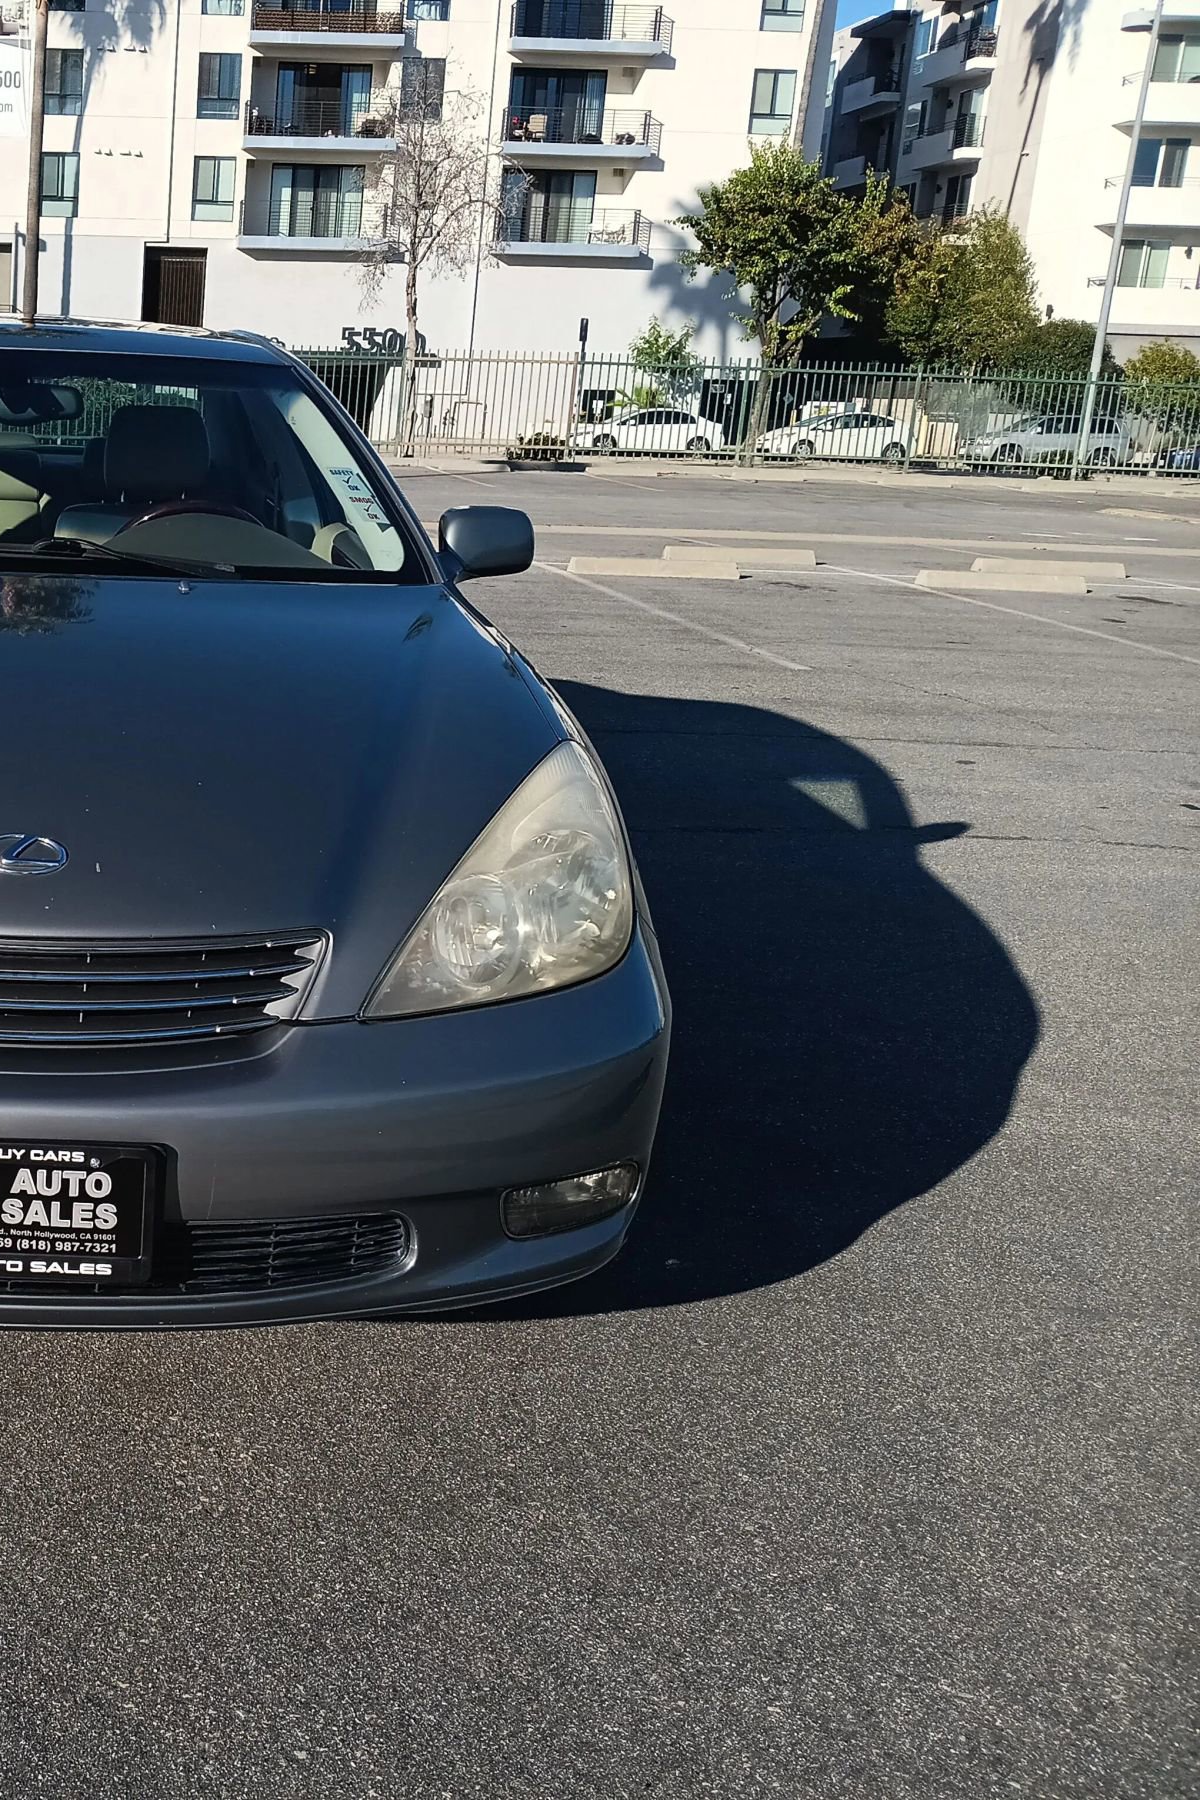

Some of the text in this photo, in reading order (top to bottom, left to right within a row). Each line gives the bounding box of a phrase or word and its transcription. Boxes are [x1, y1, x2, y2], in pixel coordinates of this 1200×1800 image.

[349, 496, 374, 504] SMOG
[30, 1149, 85, 1163] CARS
[10, 1168, 112, 1198] AUTO
[1, 1198, 118, 1230] SALES
[10, 1229, 32, 1237] North
[34, 1230, 78, 1240] Hollywood,
[79, 1232, 92, 1240] CA
[93, 1233, 116, 1241] 91601
[16, 1238, 51, 1252] (818)
[55, 1242, 117, 1253] 987-7321
[30, 1261, 112, 1275] SALES
